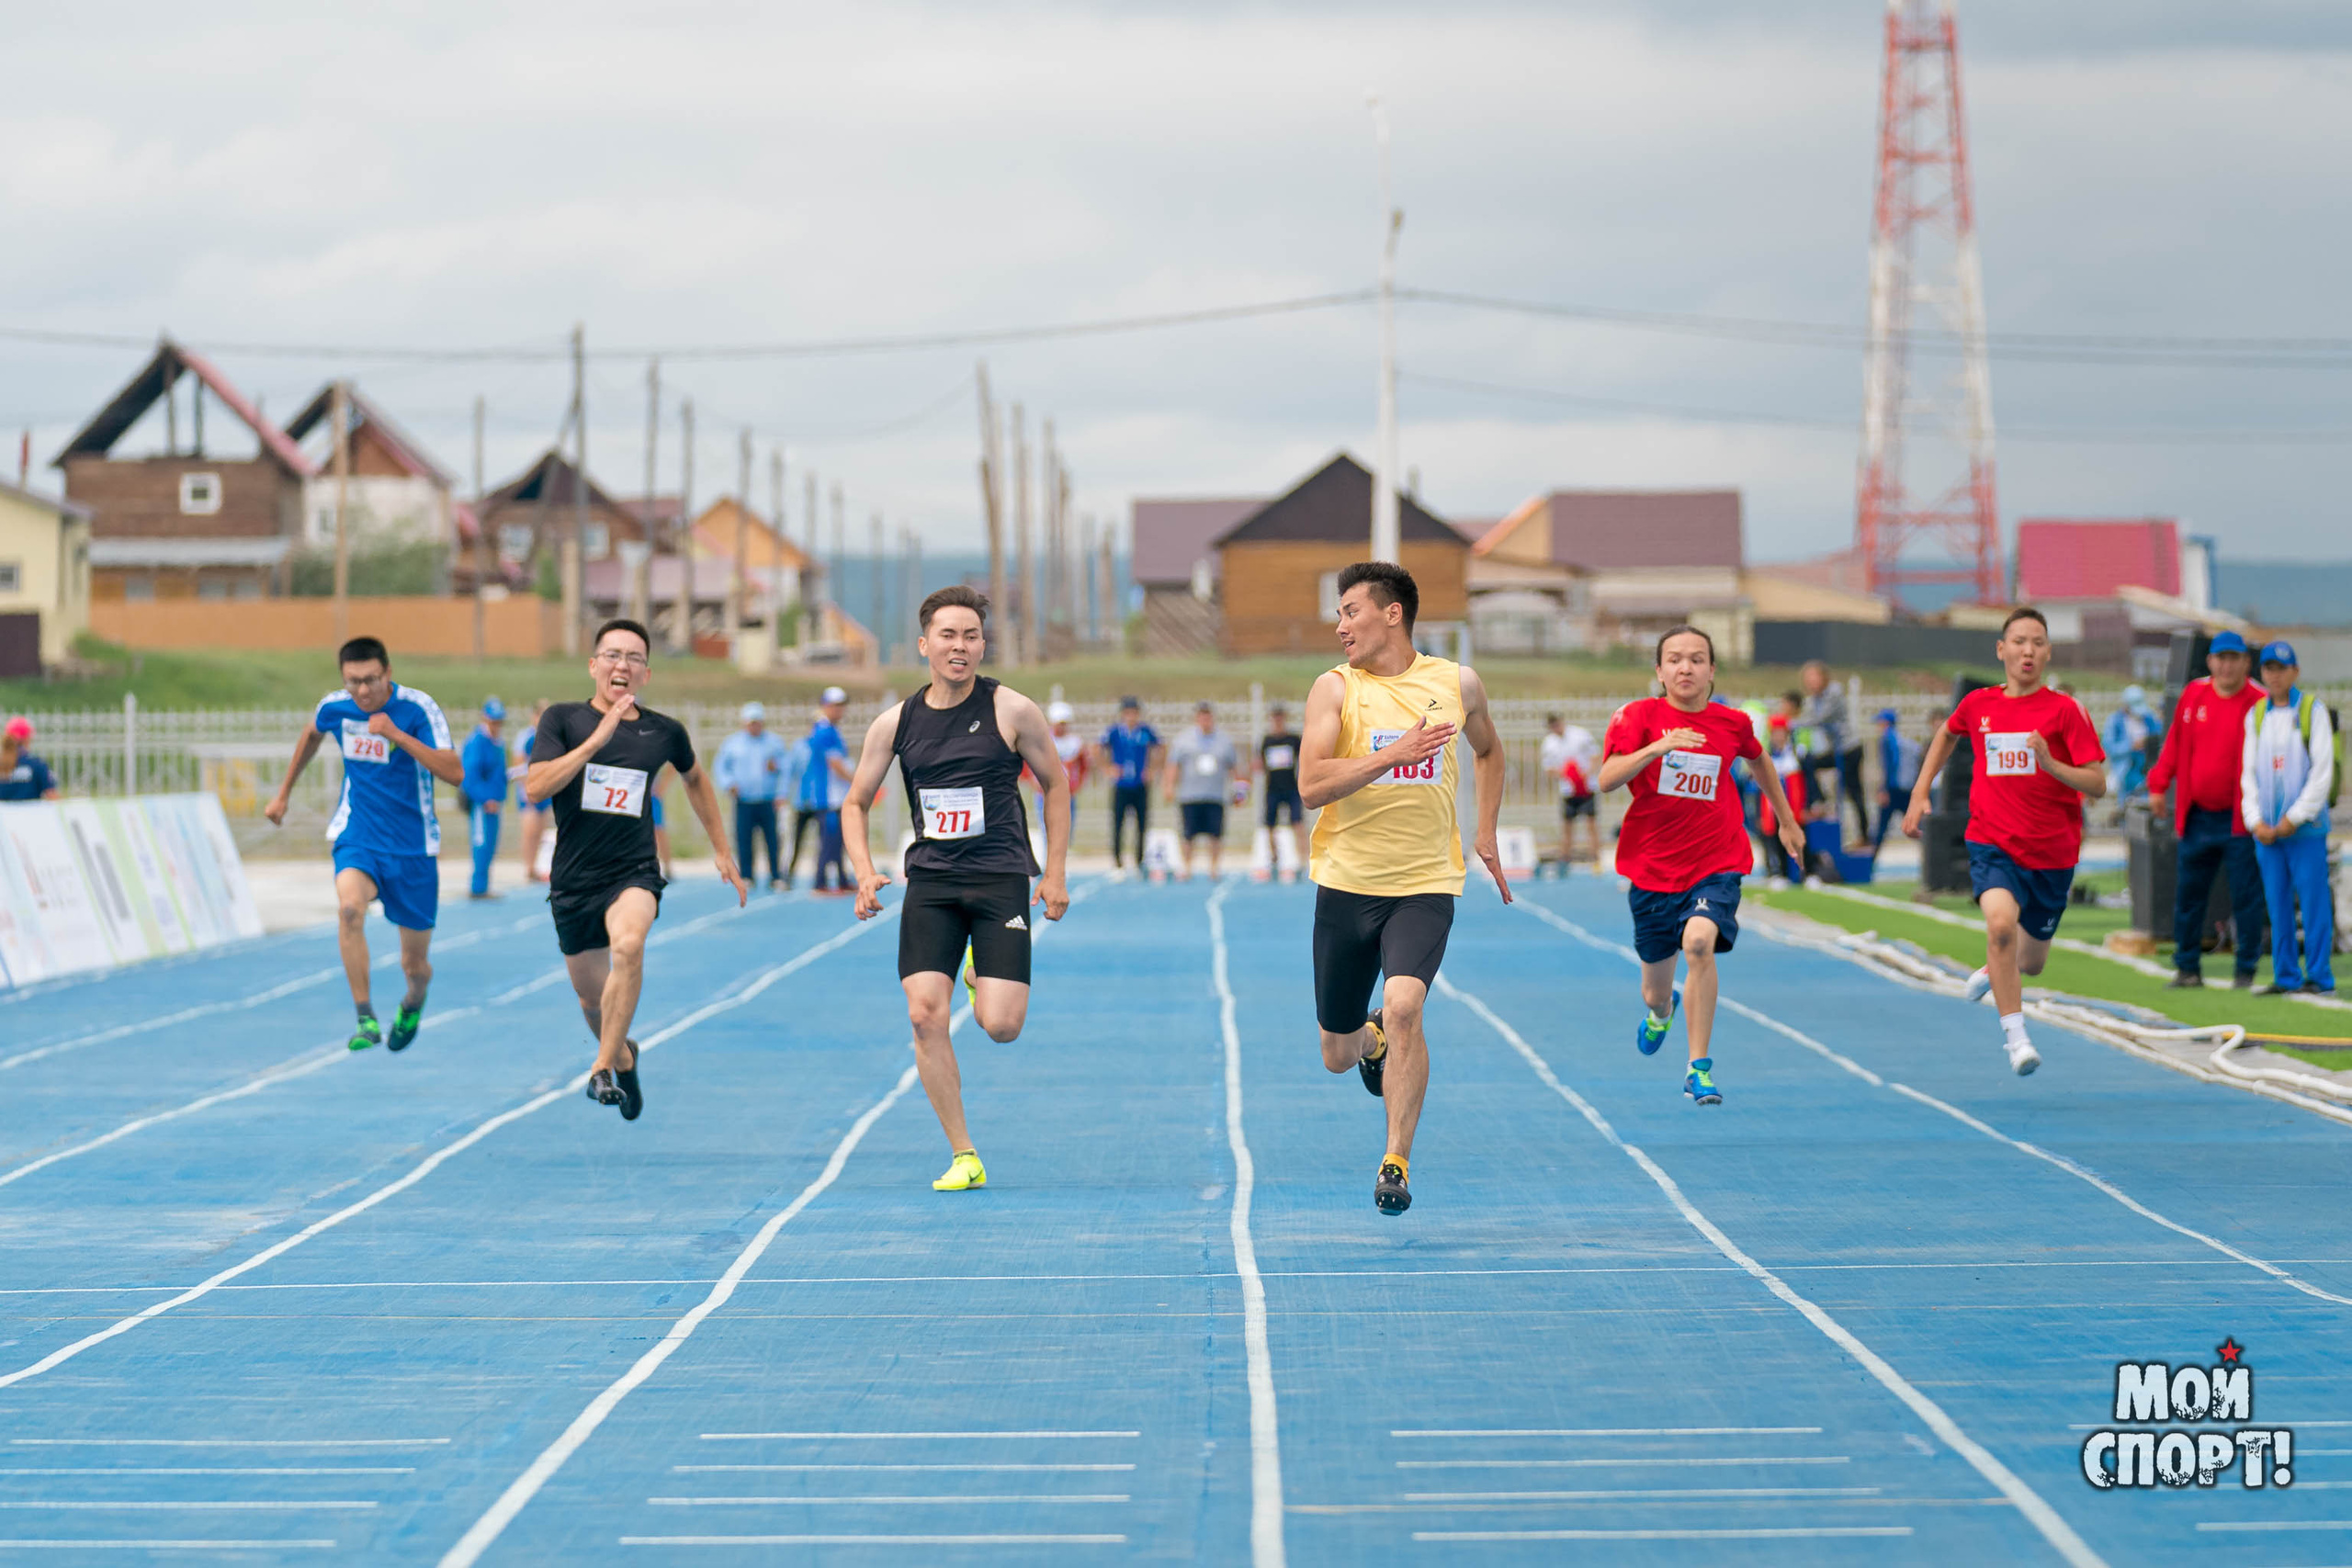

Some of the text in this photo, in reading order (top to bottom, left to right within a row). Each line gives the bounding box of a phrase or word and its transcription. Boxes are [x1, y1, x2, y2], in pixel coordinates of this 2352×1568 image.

[1997, 750, 2029, 769] 199
[1673, 772, 1713, 795] 200
[605, 786, 628, 809] 72
[936, 810, 971, 833] 277
